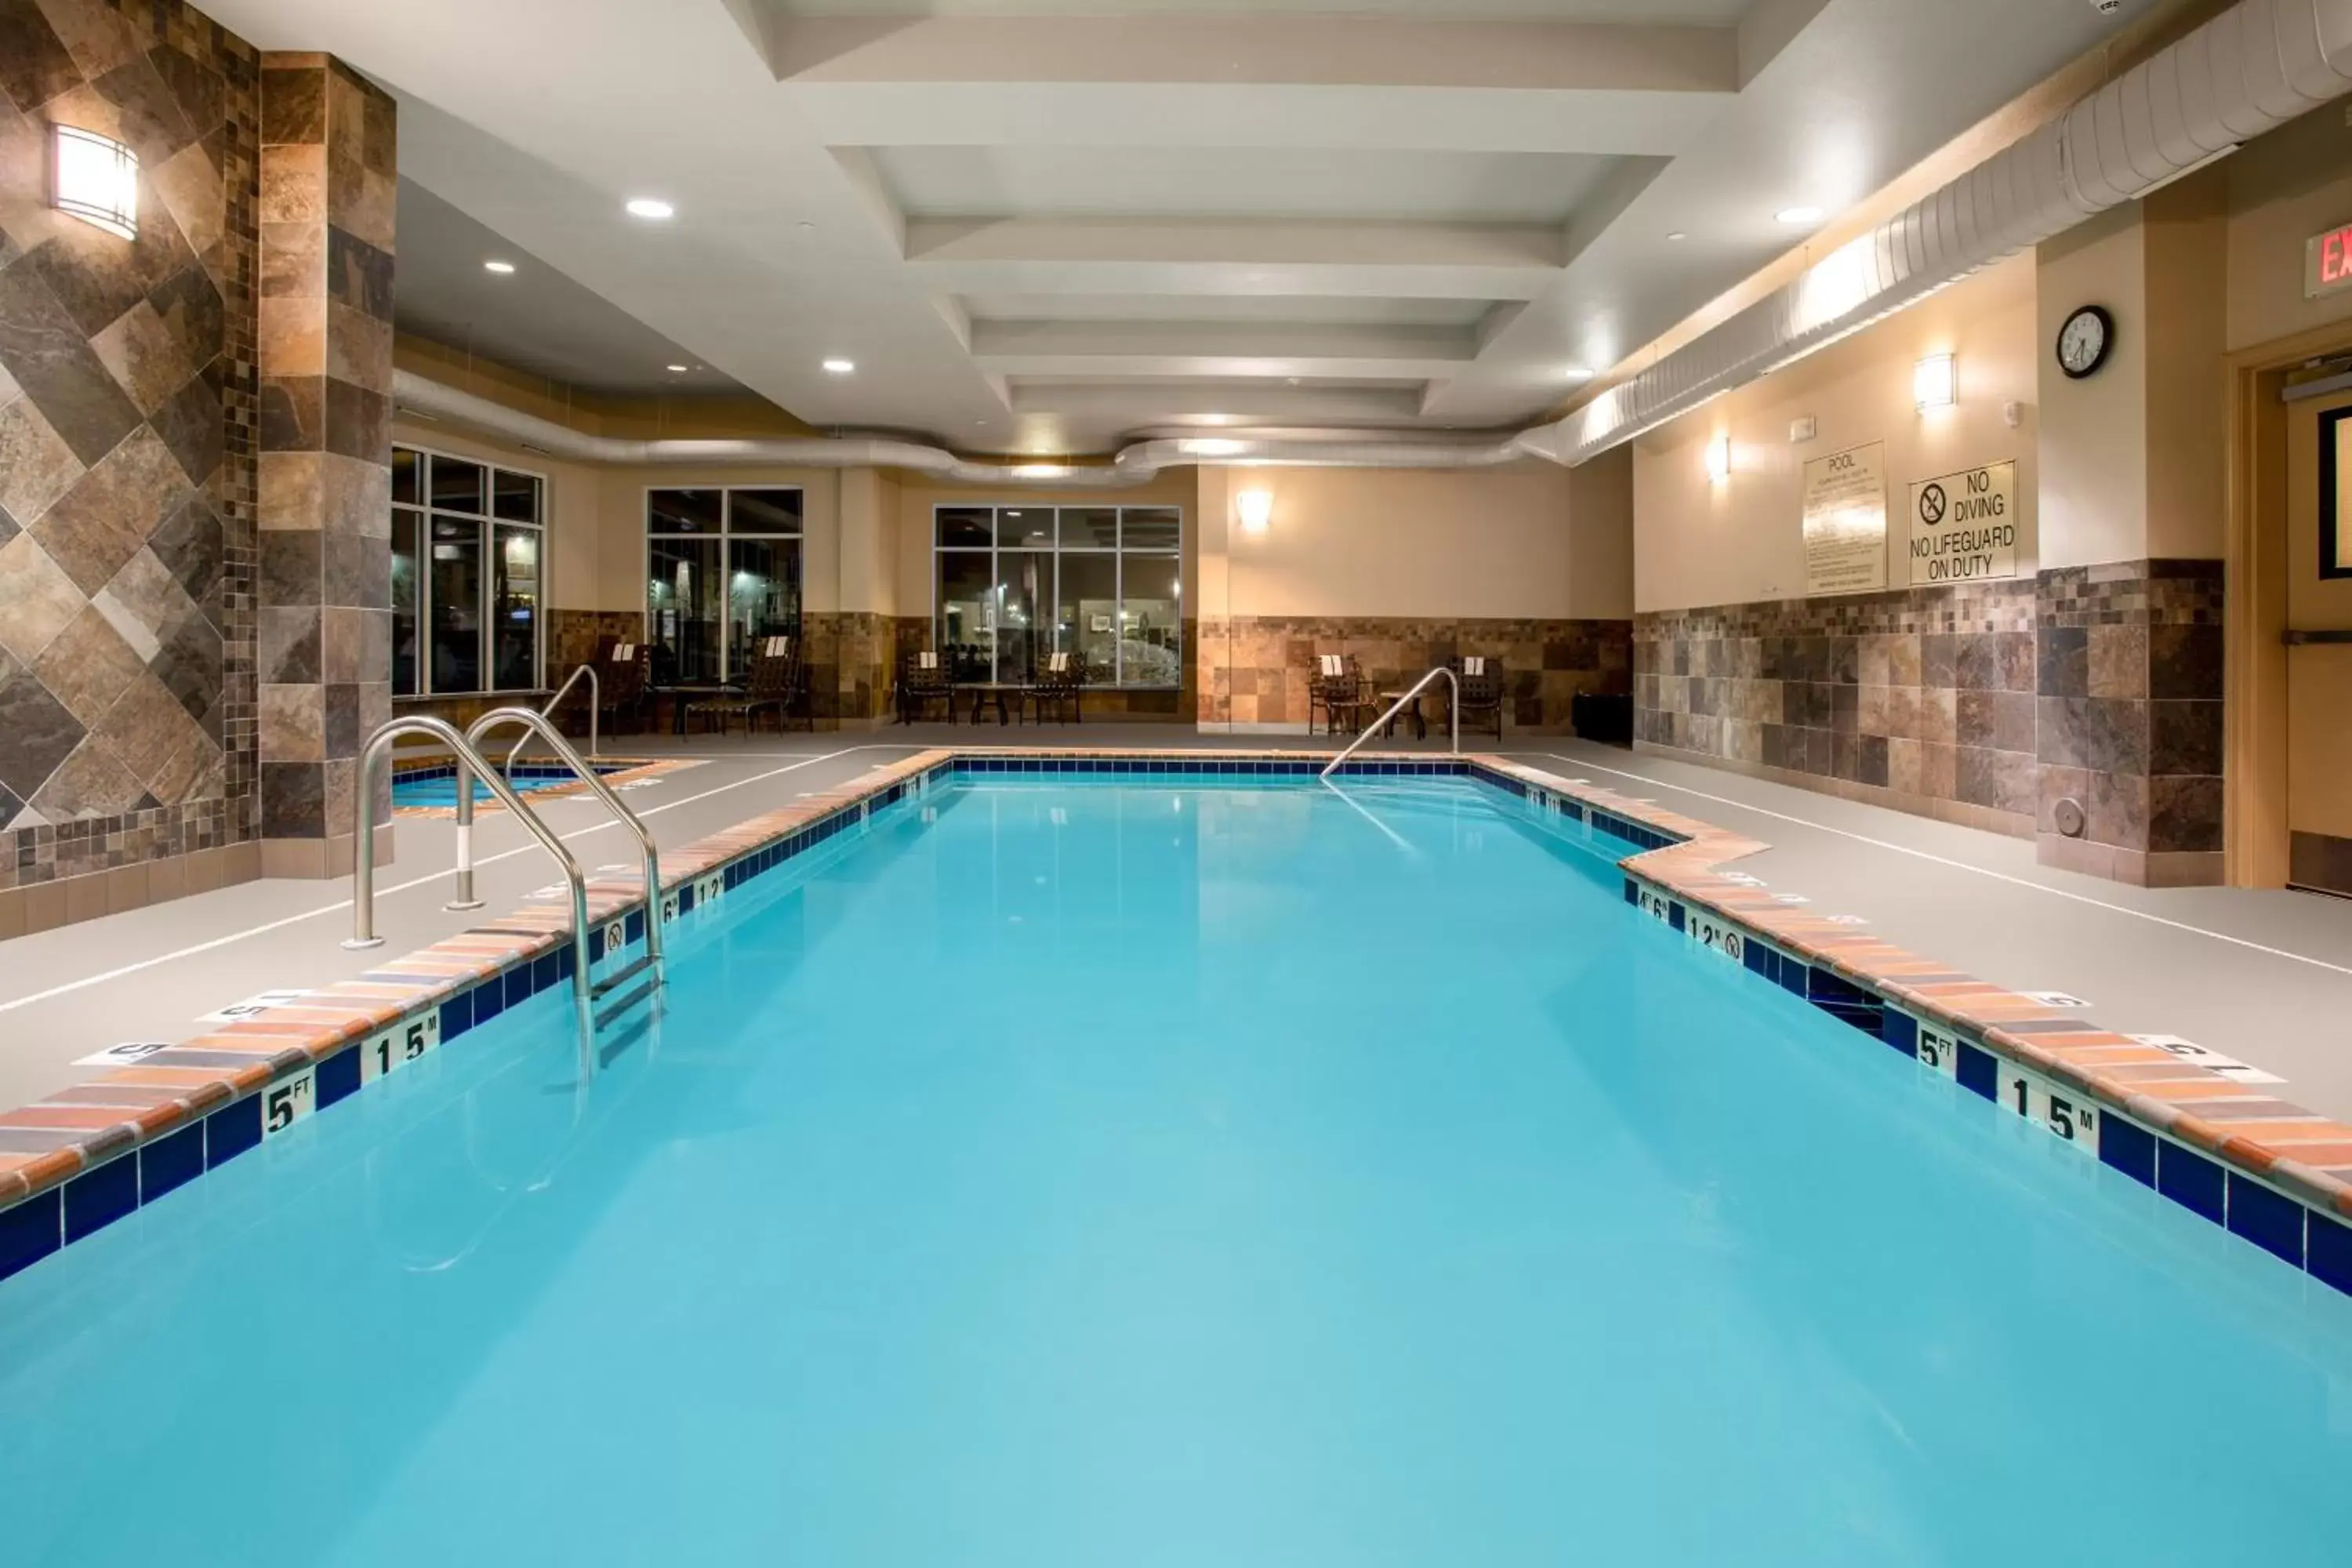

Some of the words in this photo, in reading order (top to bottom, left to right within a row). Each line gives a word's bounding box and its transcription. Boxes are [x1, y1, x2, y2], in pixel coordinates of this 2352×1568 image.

[1829, 454, 1856, 473] POOL
[1967, 470, 1989, 495] NO
[1955, 493, 2004, 522] DIVING
[1911, 536, 1930, 558] NO
[1933, 524, 2014, 556] LIFEGUARD
[1929, 559, 1948, 580] ON
[1953, 554, 1992, 578] DUTY
